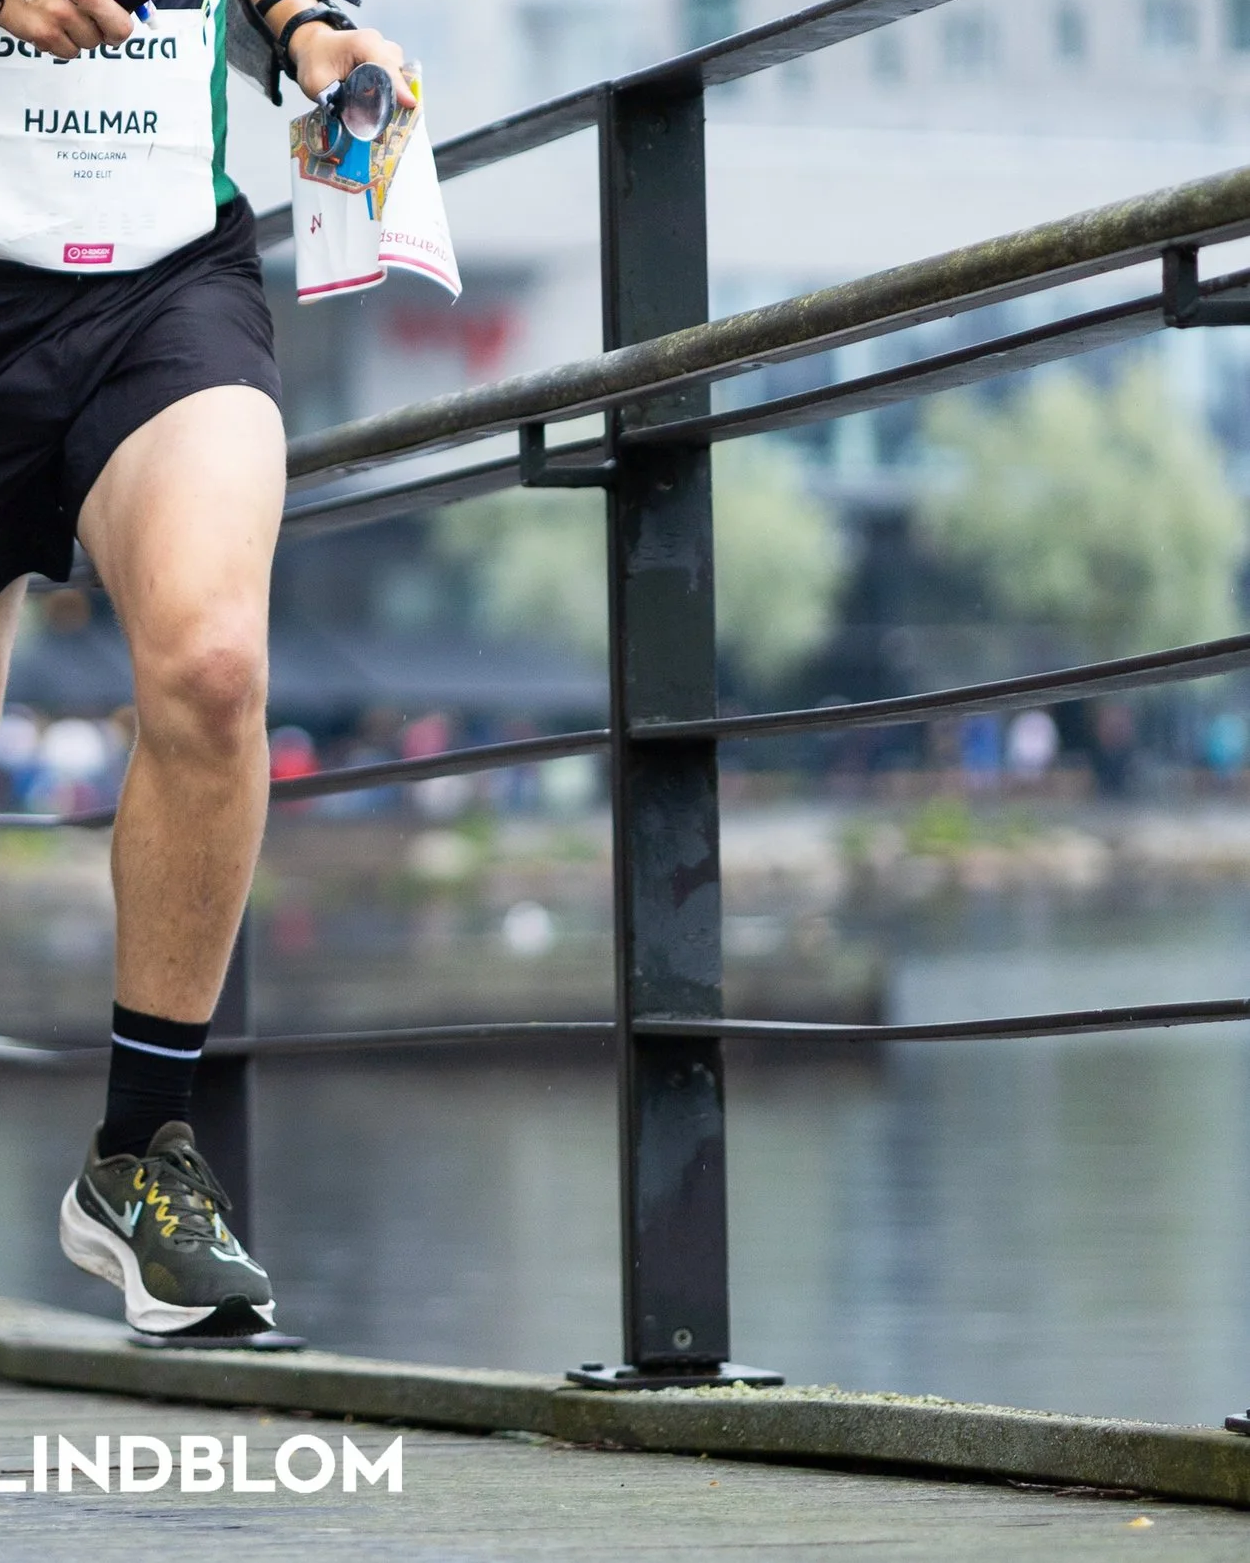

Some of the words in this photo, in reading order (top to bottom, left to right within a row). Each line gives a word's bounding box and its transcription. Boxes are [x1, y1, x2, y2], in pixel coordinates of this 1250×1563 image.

[24, 108, 158, 134] HJALMAR
[56, 150, 69, 160] FK
[73, 169, 93, 179] H20
[95, 169, 112, 179] ELIT
